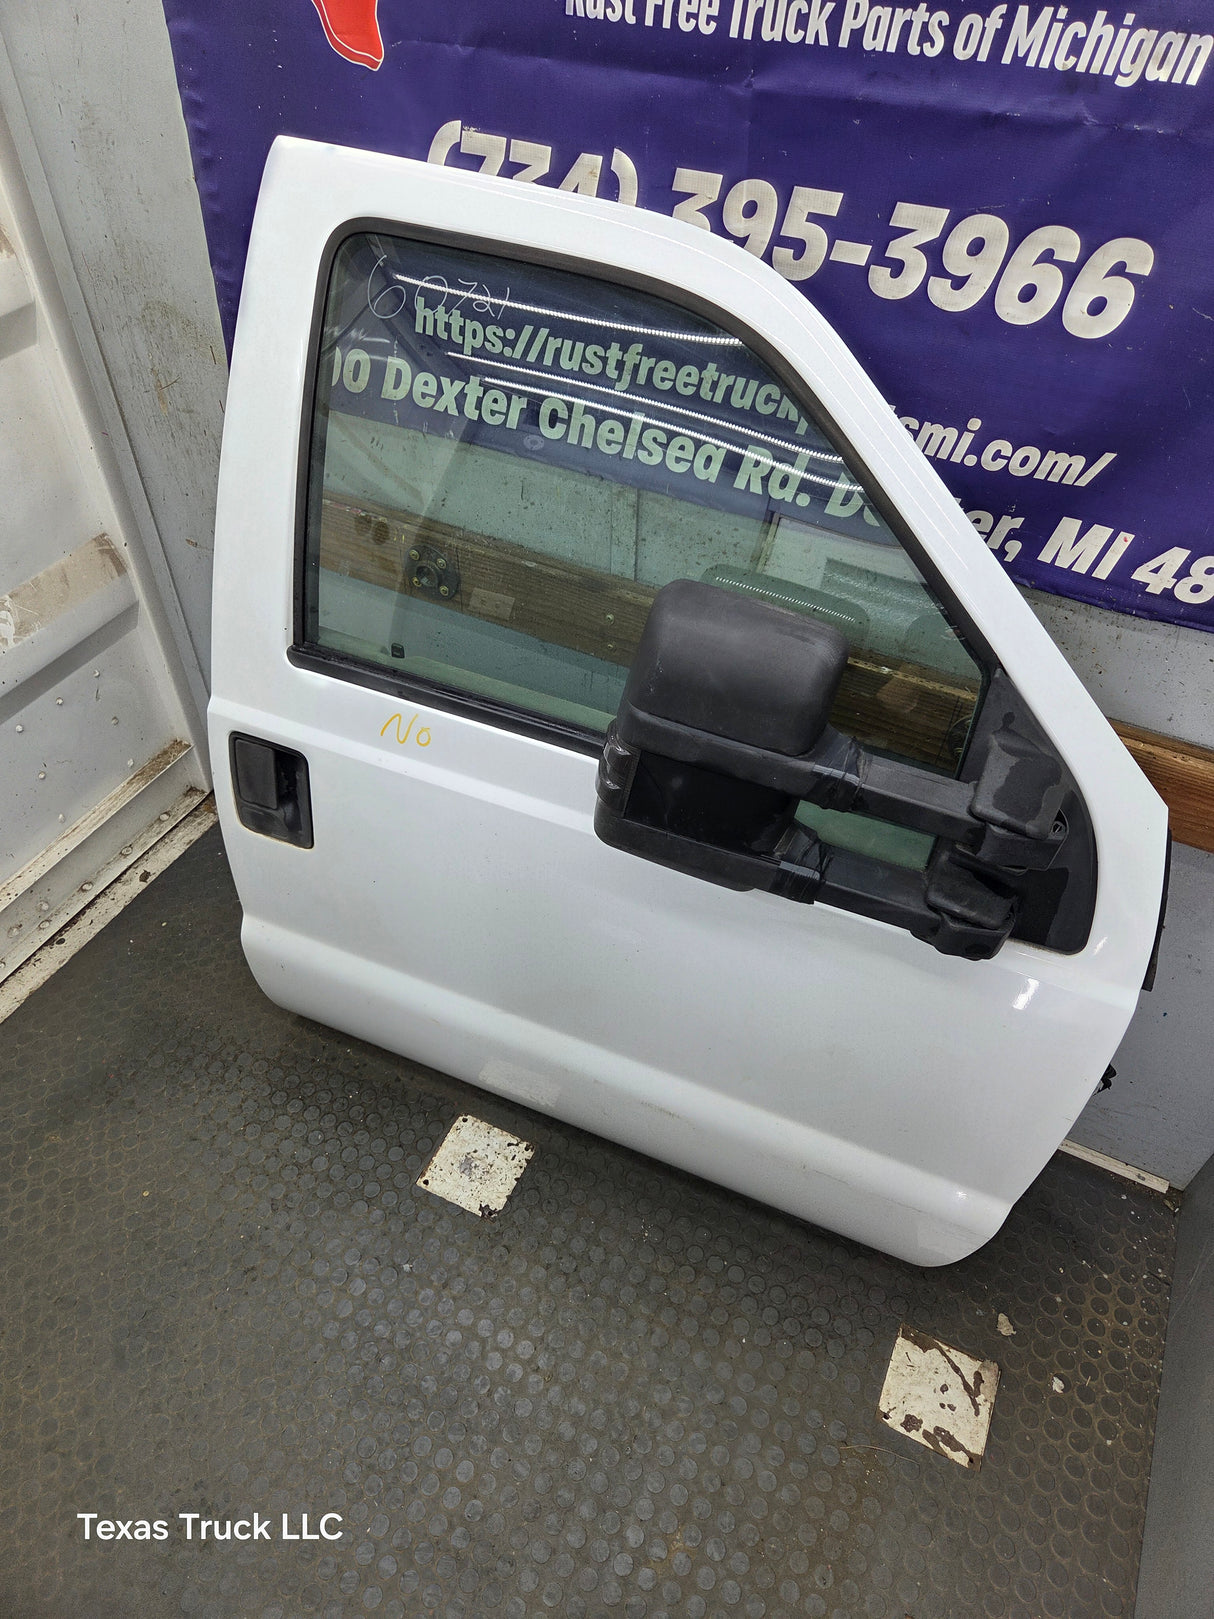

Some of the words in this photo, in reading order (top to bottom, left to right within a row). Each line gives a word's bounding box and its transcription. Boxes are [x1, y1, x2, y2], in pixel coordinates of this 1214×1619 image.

[728, 0, 836, 46] Truck
[838, 0, 950, 57] Parts
[952, 4, 1008, 62] of
[1000, 5, 1214, 88] Michigan
[671, 166, 1155, 342] 395-3966
[380, 355, 529, 432] Dexter
[538, 394, 729, 485] Chelsea
[733, 444, 812, 507] Rd.
[1037, 516, 1136, 581] MI
